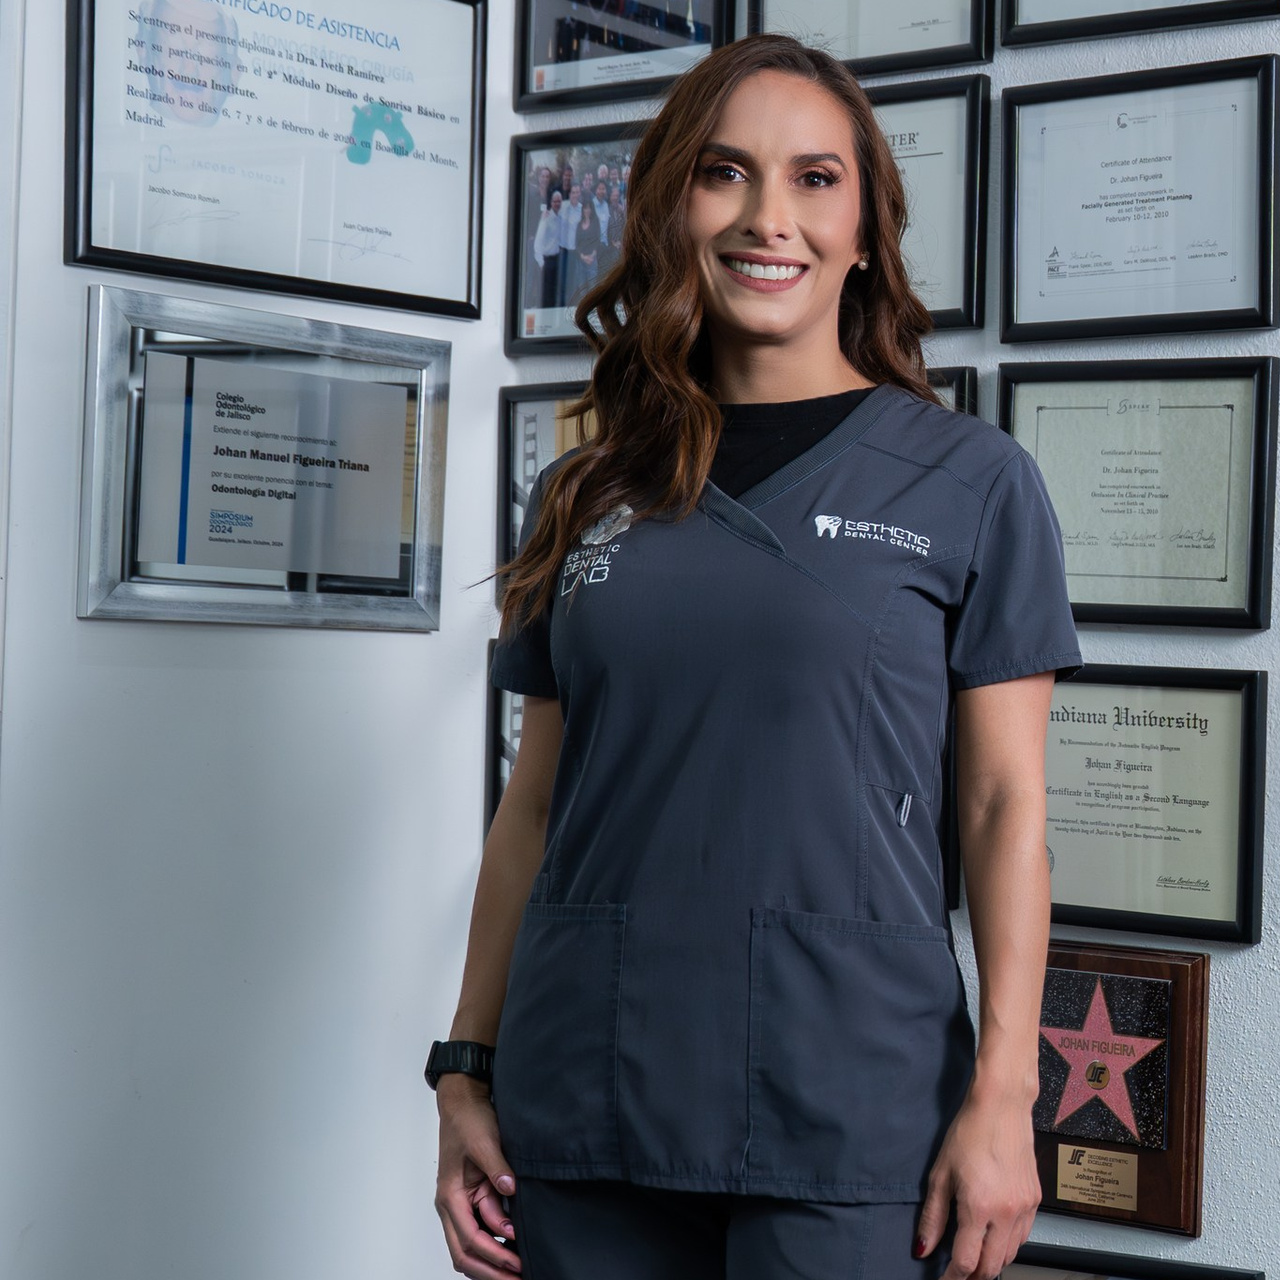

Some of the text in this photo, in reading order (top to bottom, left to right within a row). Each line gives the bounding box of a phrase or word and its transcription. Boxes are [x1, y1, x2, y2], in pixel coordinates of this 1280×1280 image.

[295, 12, 315, 30] DE
[317, 18, 400, 52] ASISTENCIA
[127, 59, 258, 101] Jacobo Somoza Institute.
[213, 446, 369, 472] Johan Manuel Figueira Triana
[211, 484, 296, 500] Odontología Digital
[844, 530, 929, 556] DENTAL CENTER
[845, 520, 931, 548] ESTHETIC
[564, 556, 612, 576] DENTAL
[567, 544, 620, 563] ESTHETIC
[562, 567, 608, 596] LAB
[1113, 706, 1209, 735] University
[1085, 757, 1152, 773] Johan Figueira
[1059, 1037, 1136, 1057] JOHAN FIGUEIRA
